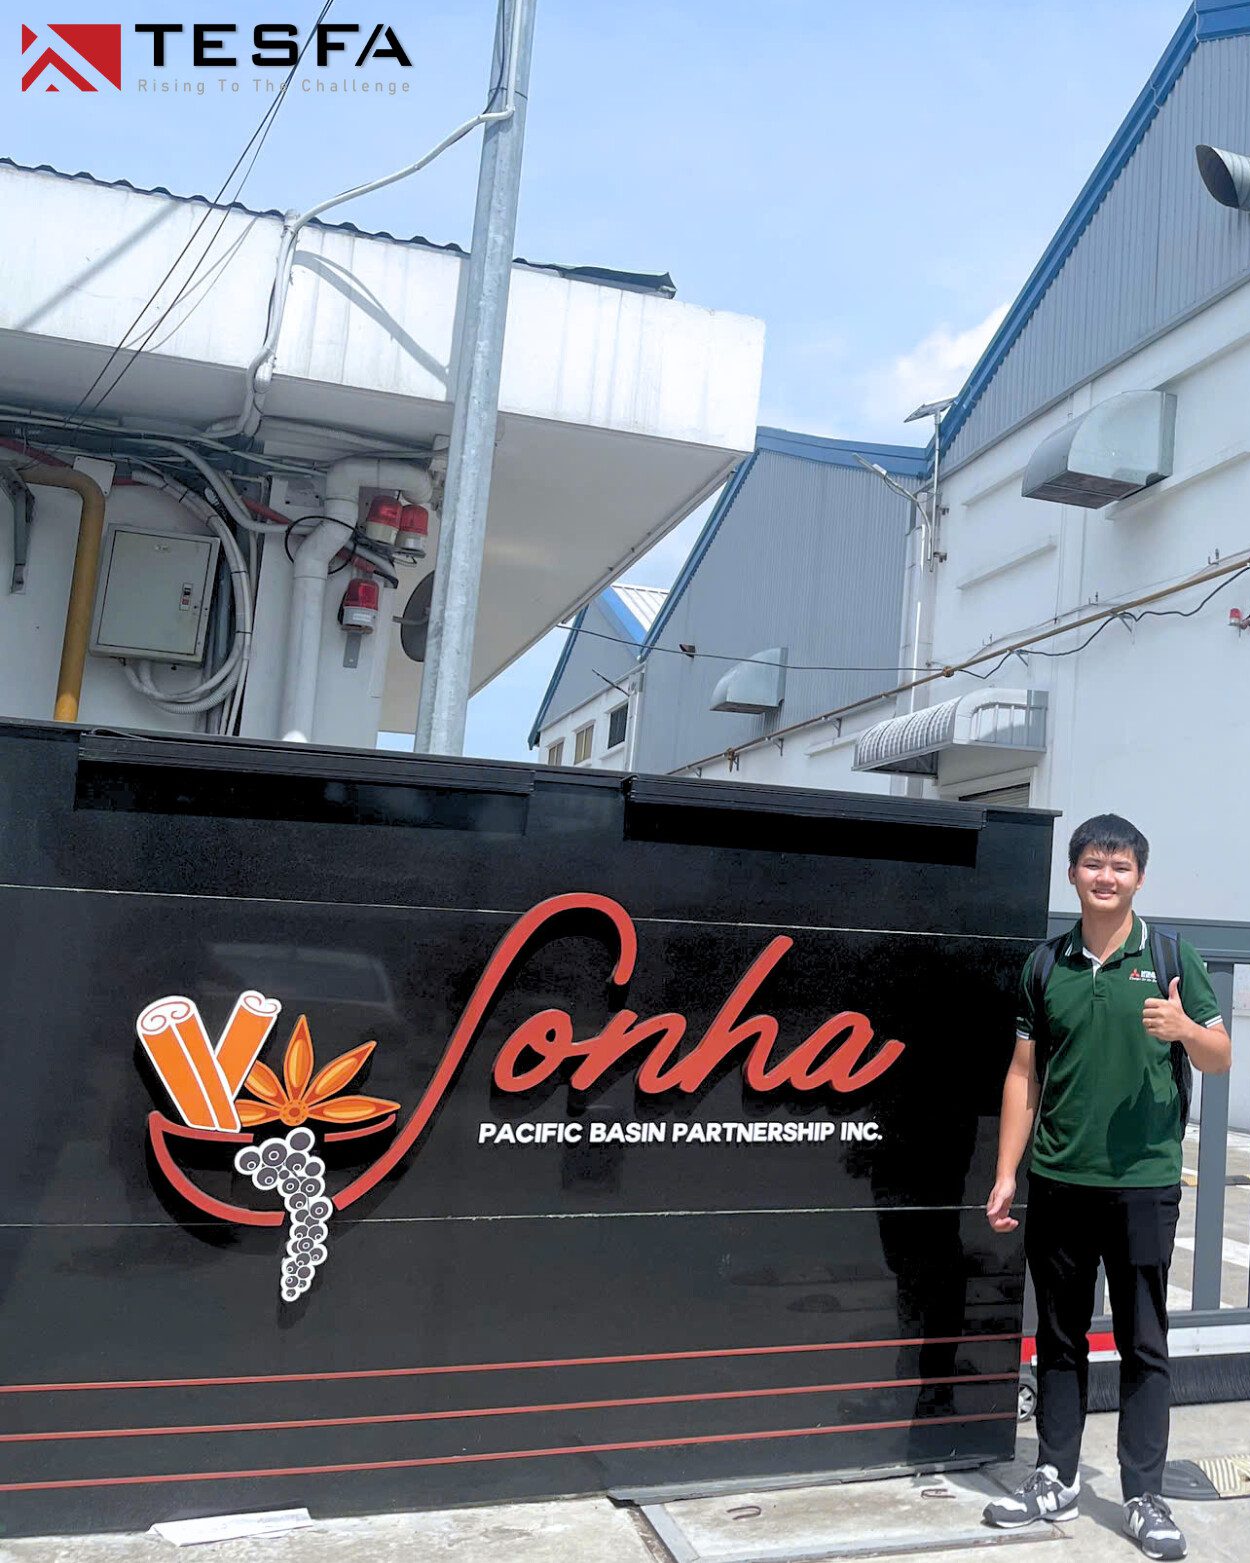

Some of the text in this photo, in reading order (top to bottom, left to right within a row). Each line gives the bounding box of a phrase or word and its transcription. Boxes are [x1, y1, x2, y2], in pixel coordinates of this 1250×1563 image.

[478, 1121, 883, 1144] PACIFIC BASIN PARTNERSHIP INC.
